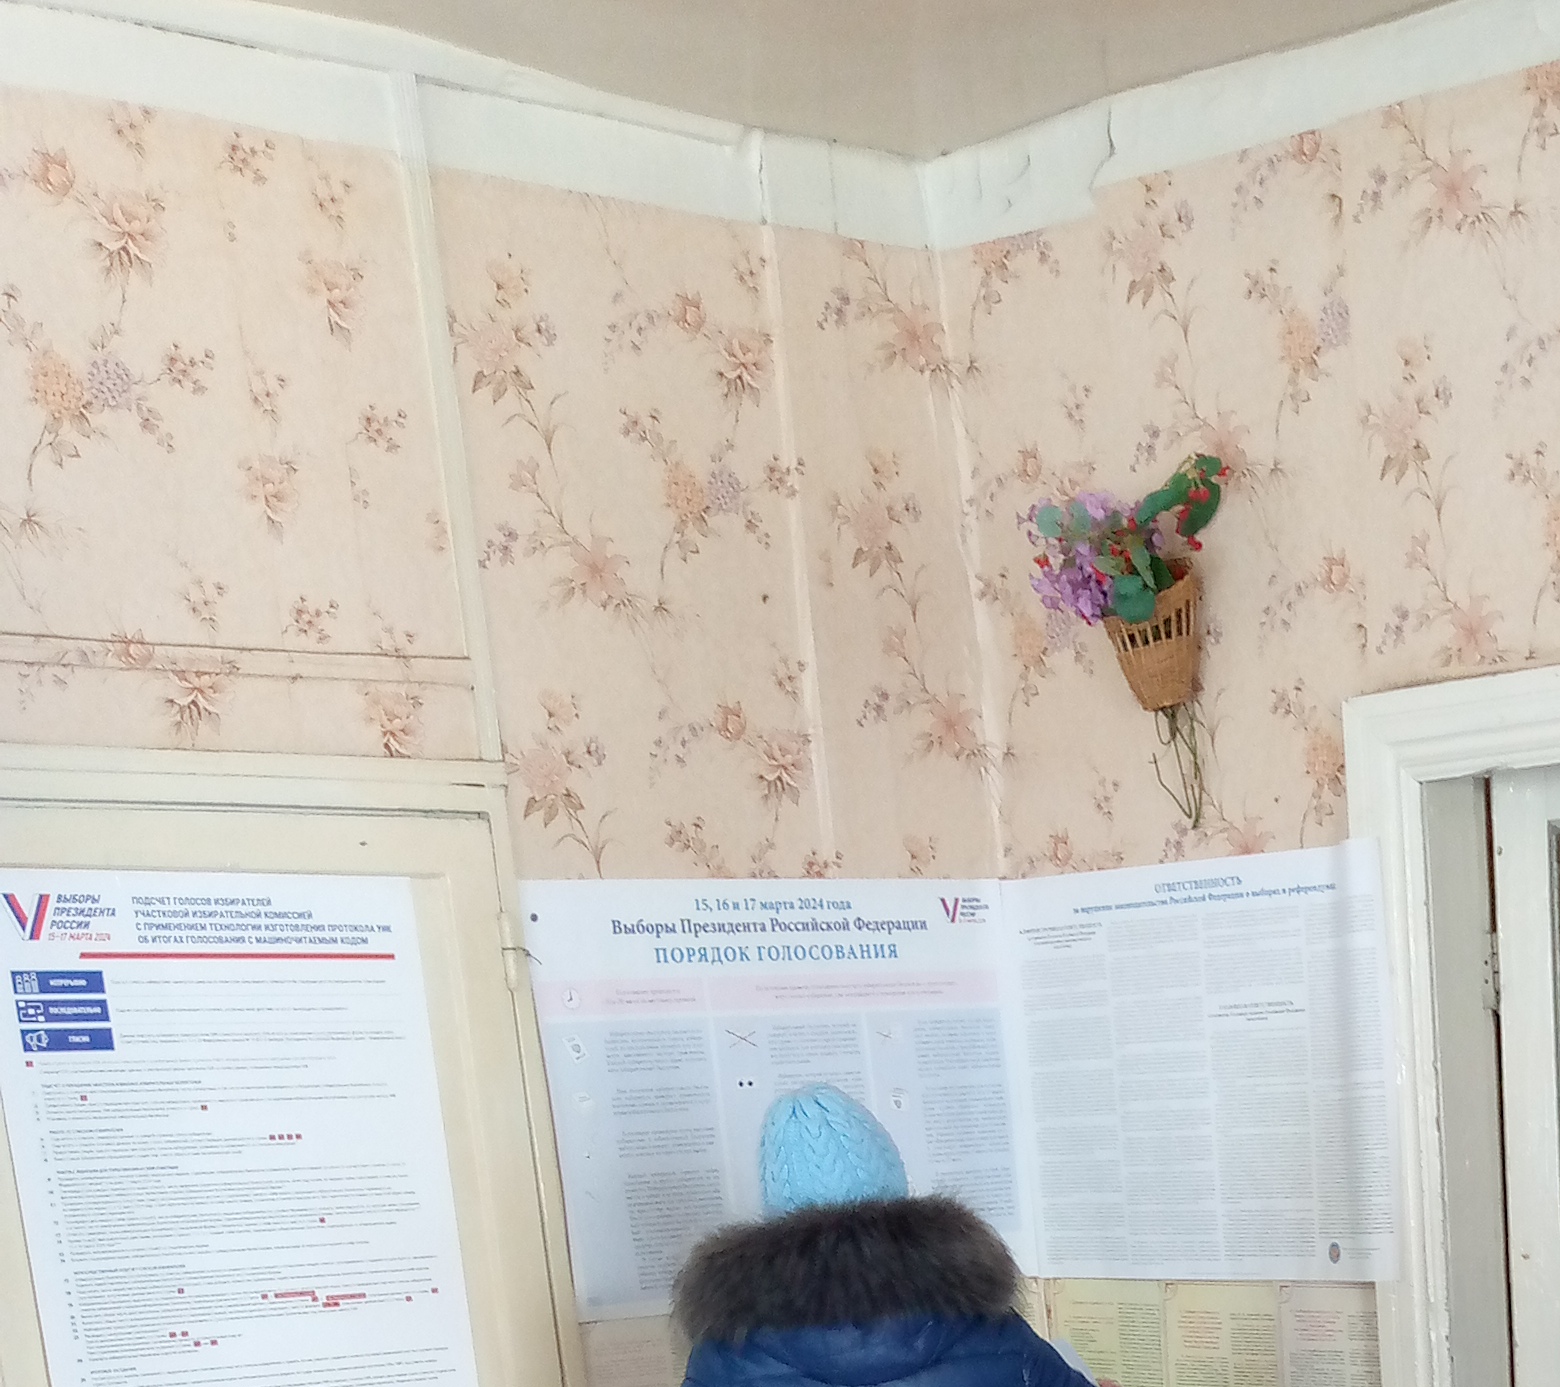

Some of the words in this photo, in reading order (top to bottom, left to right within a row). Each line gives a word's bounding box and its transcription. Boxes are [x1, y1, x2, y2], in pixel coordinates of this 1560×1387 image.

[56, 893, 101, 904] ВЫБОРЫ
[132, 896, 171, 907] ПОДСЧЕТ
[173, 896, 212, 907] ГОЛОСОВ
[214, 897, 272, 907] ИЗБИРАТЕЛЕЙ
[694, 899, 713, 912] 15,
[715, 899, 730, 911] 16
[732, 902, 740, 911] и
[743, 898, 756, 911] 17
[760, 900, 795, 914] марта
[797, 898, 824, 910] 2024
[826, 900, 852, 911] года
[53, 906, 116, 918] ПРЕЗИДЕНТА
[134, 908, 190, 919] УЧАСТКОВОЙ
[191, 908, 261, 919] ИЗБИРАТЕЛЬНОЙ
[264, 910, 313, 920] КОМИССИЕЙ
[50, 920, 90, 930] РОССИИ
[144, 923, 207, 932] ПРИМЕНЕНИЕМ
[210, 923, 263, 932] ТЕХНОЛОГИИ
[264, 924, 326, 932] ИЗГОТОВЛЕНИЯ
[611, 918, 677, 939] Выборы
[680, 918, 767, 938] Президента
[769, 917, 850, 934] Российской
[853, 917, 928, 935] Федерации
[138, 935, 149, 944] ОБ
[151, 935, 184, 944] ИТОГАХ
[185, 935, 246, 944] ГОЛОСОВАНИЯ
[654, 946, 750, 966] ПОРЯДОК
[757, 943, 899, 963] ГОЛОСОВАНИЯ
